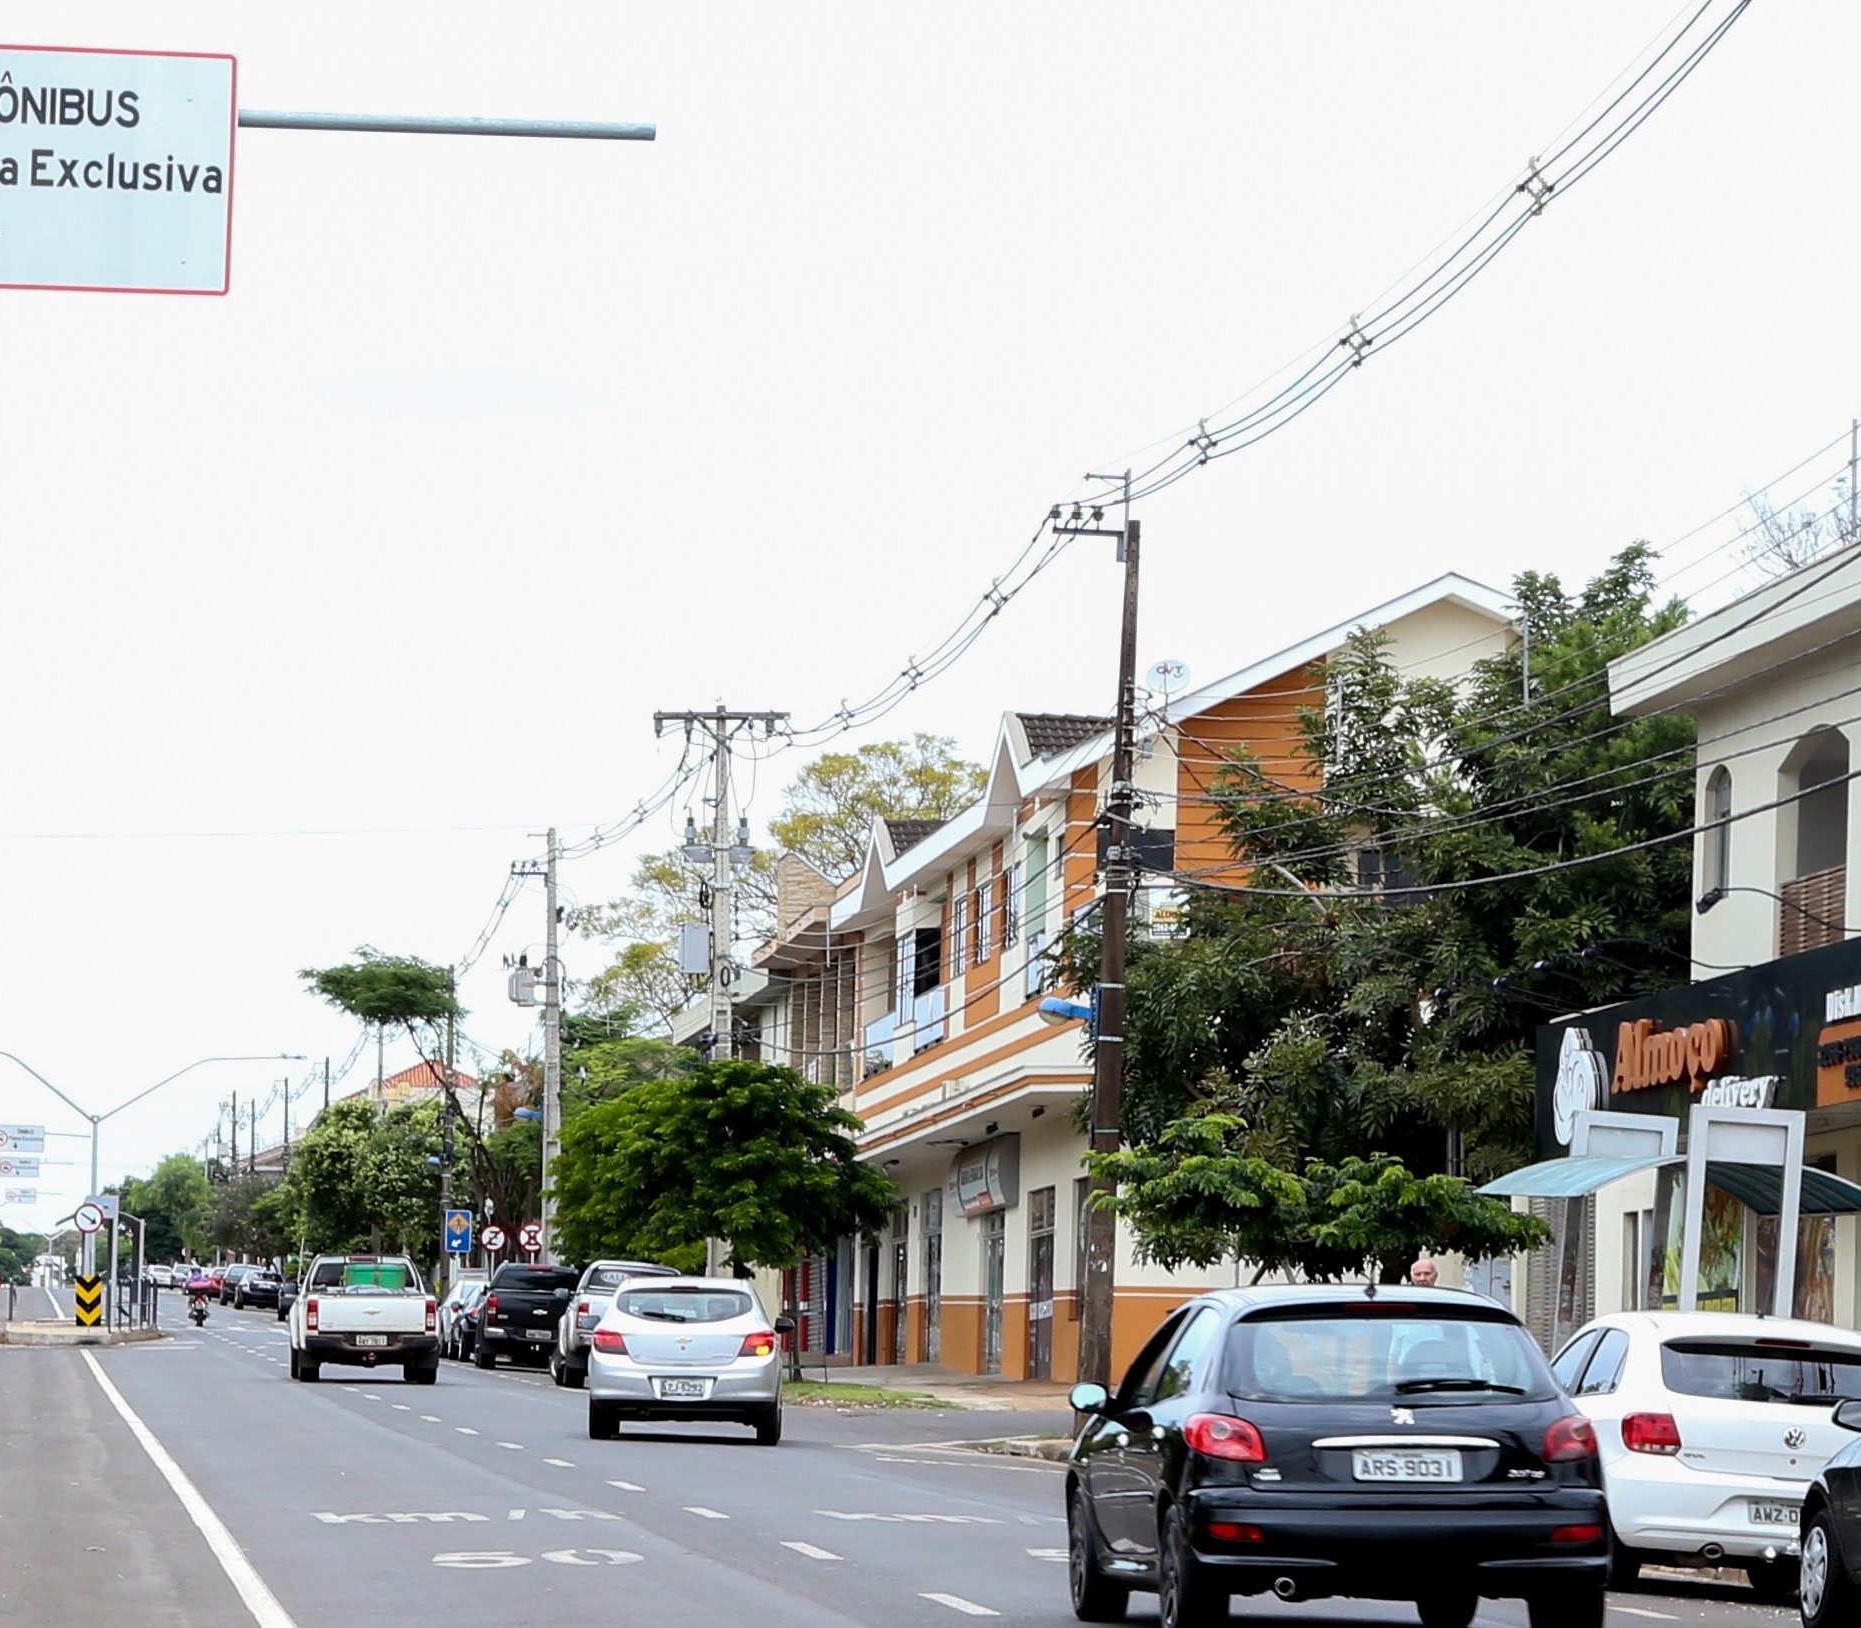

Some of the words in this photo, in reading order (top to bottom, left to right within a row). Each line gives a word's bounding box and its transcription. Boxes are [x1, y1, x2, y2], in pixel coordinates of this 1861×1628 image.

[30, 148, 223, 194] Exclusiva
[1611, 1018, 1724, 1094] Almoço
[1701, 1075, 1779, 1109] delivery
[1359, 1459, 1455, 1477] ARS-9031
[1752, 1506, 1799, 1524] AWZ-0
[432, 1548, 645, 1568] 50
